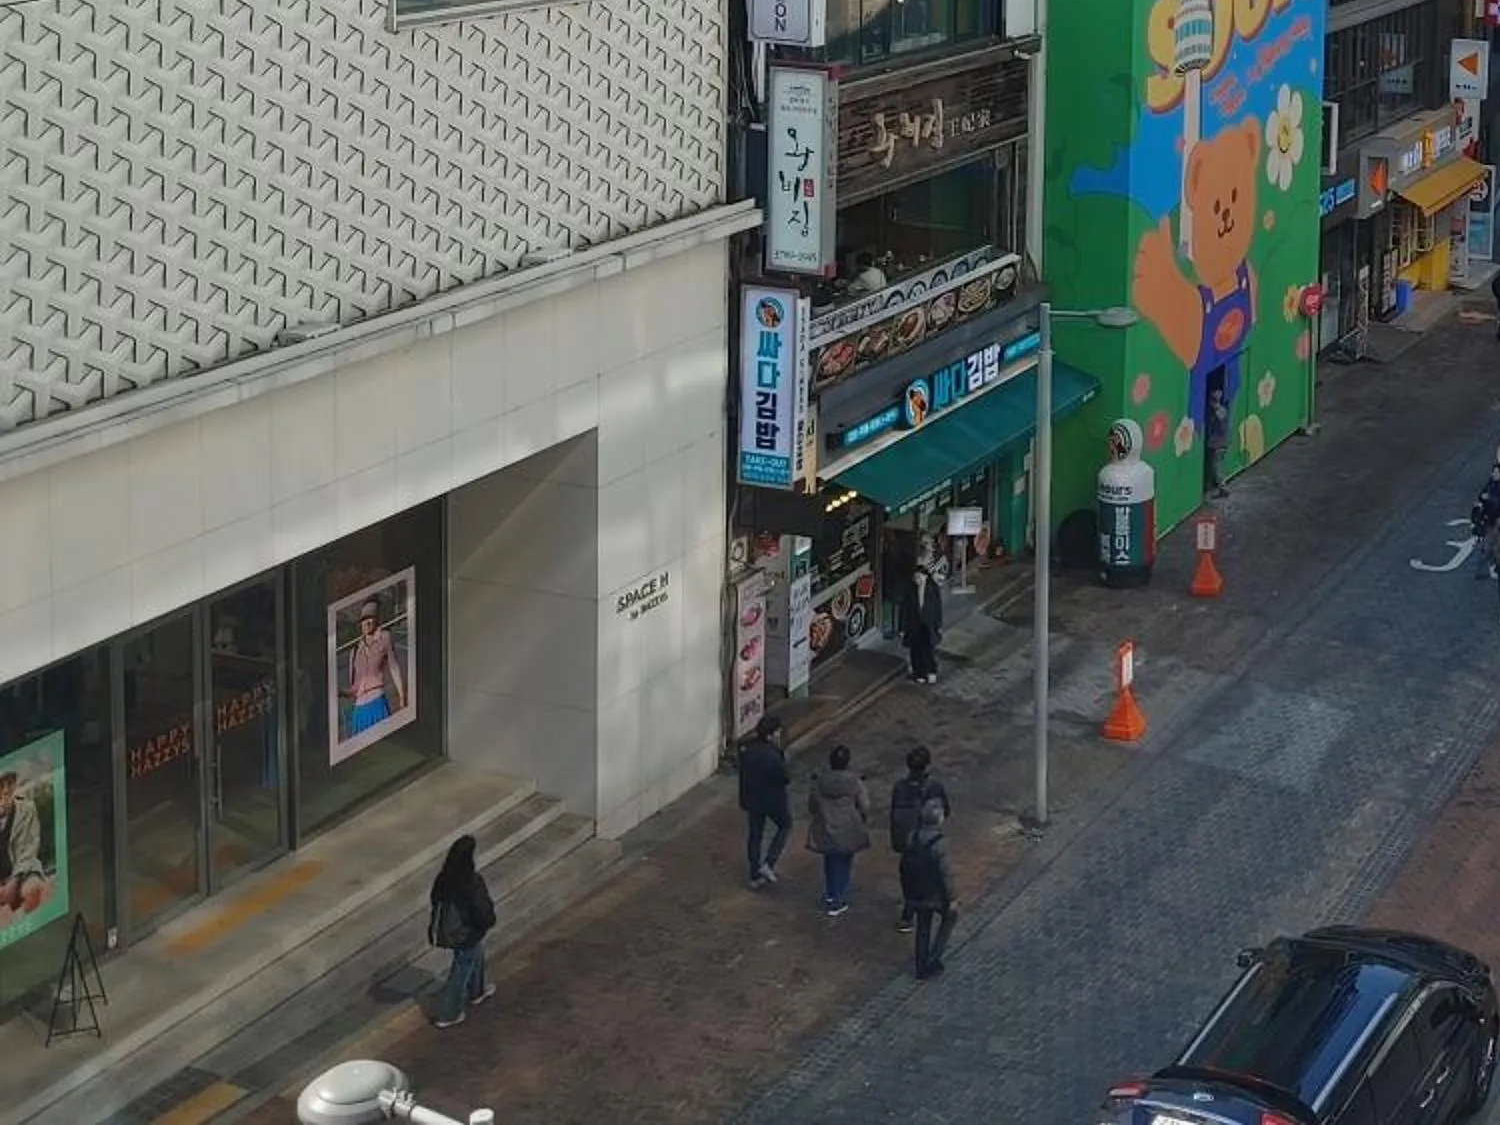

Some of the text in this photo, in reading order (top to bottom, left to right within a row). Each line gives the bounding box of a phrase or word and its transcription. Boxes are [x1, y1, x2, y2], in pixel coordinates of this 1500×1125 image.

[755, 330, 783, 452] 싸다김밥
[932, 341, 1001, 412] 싸다김밥
[615, 570, 670, 614] SPACE H
